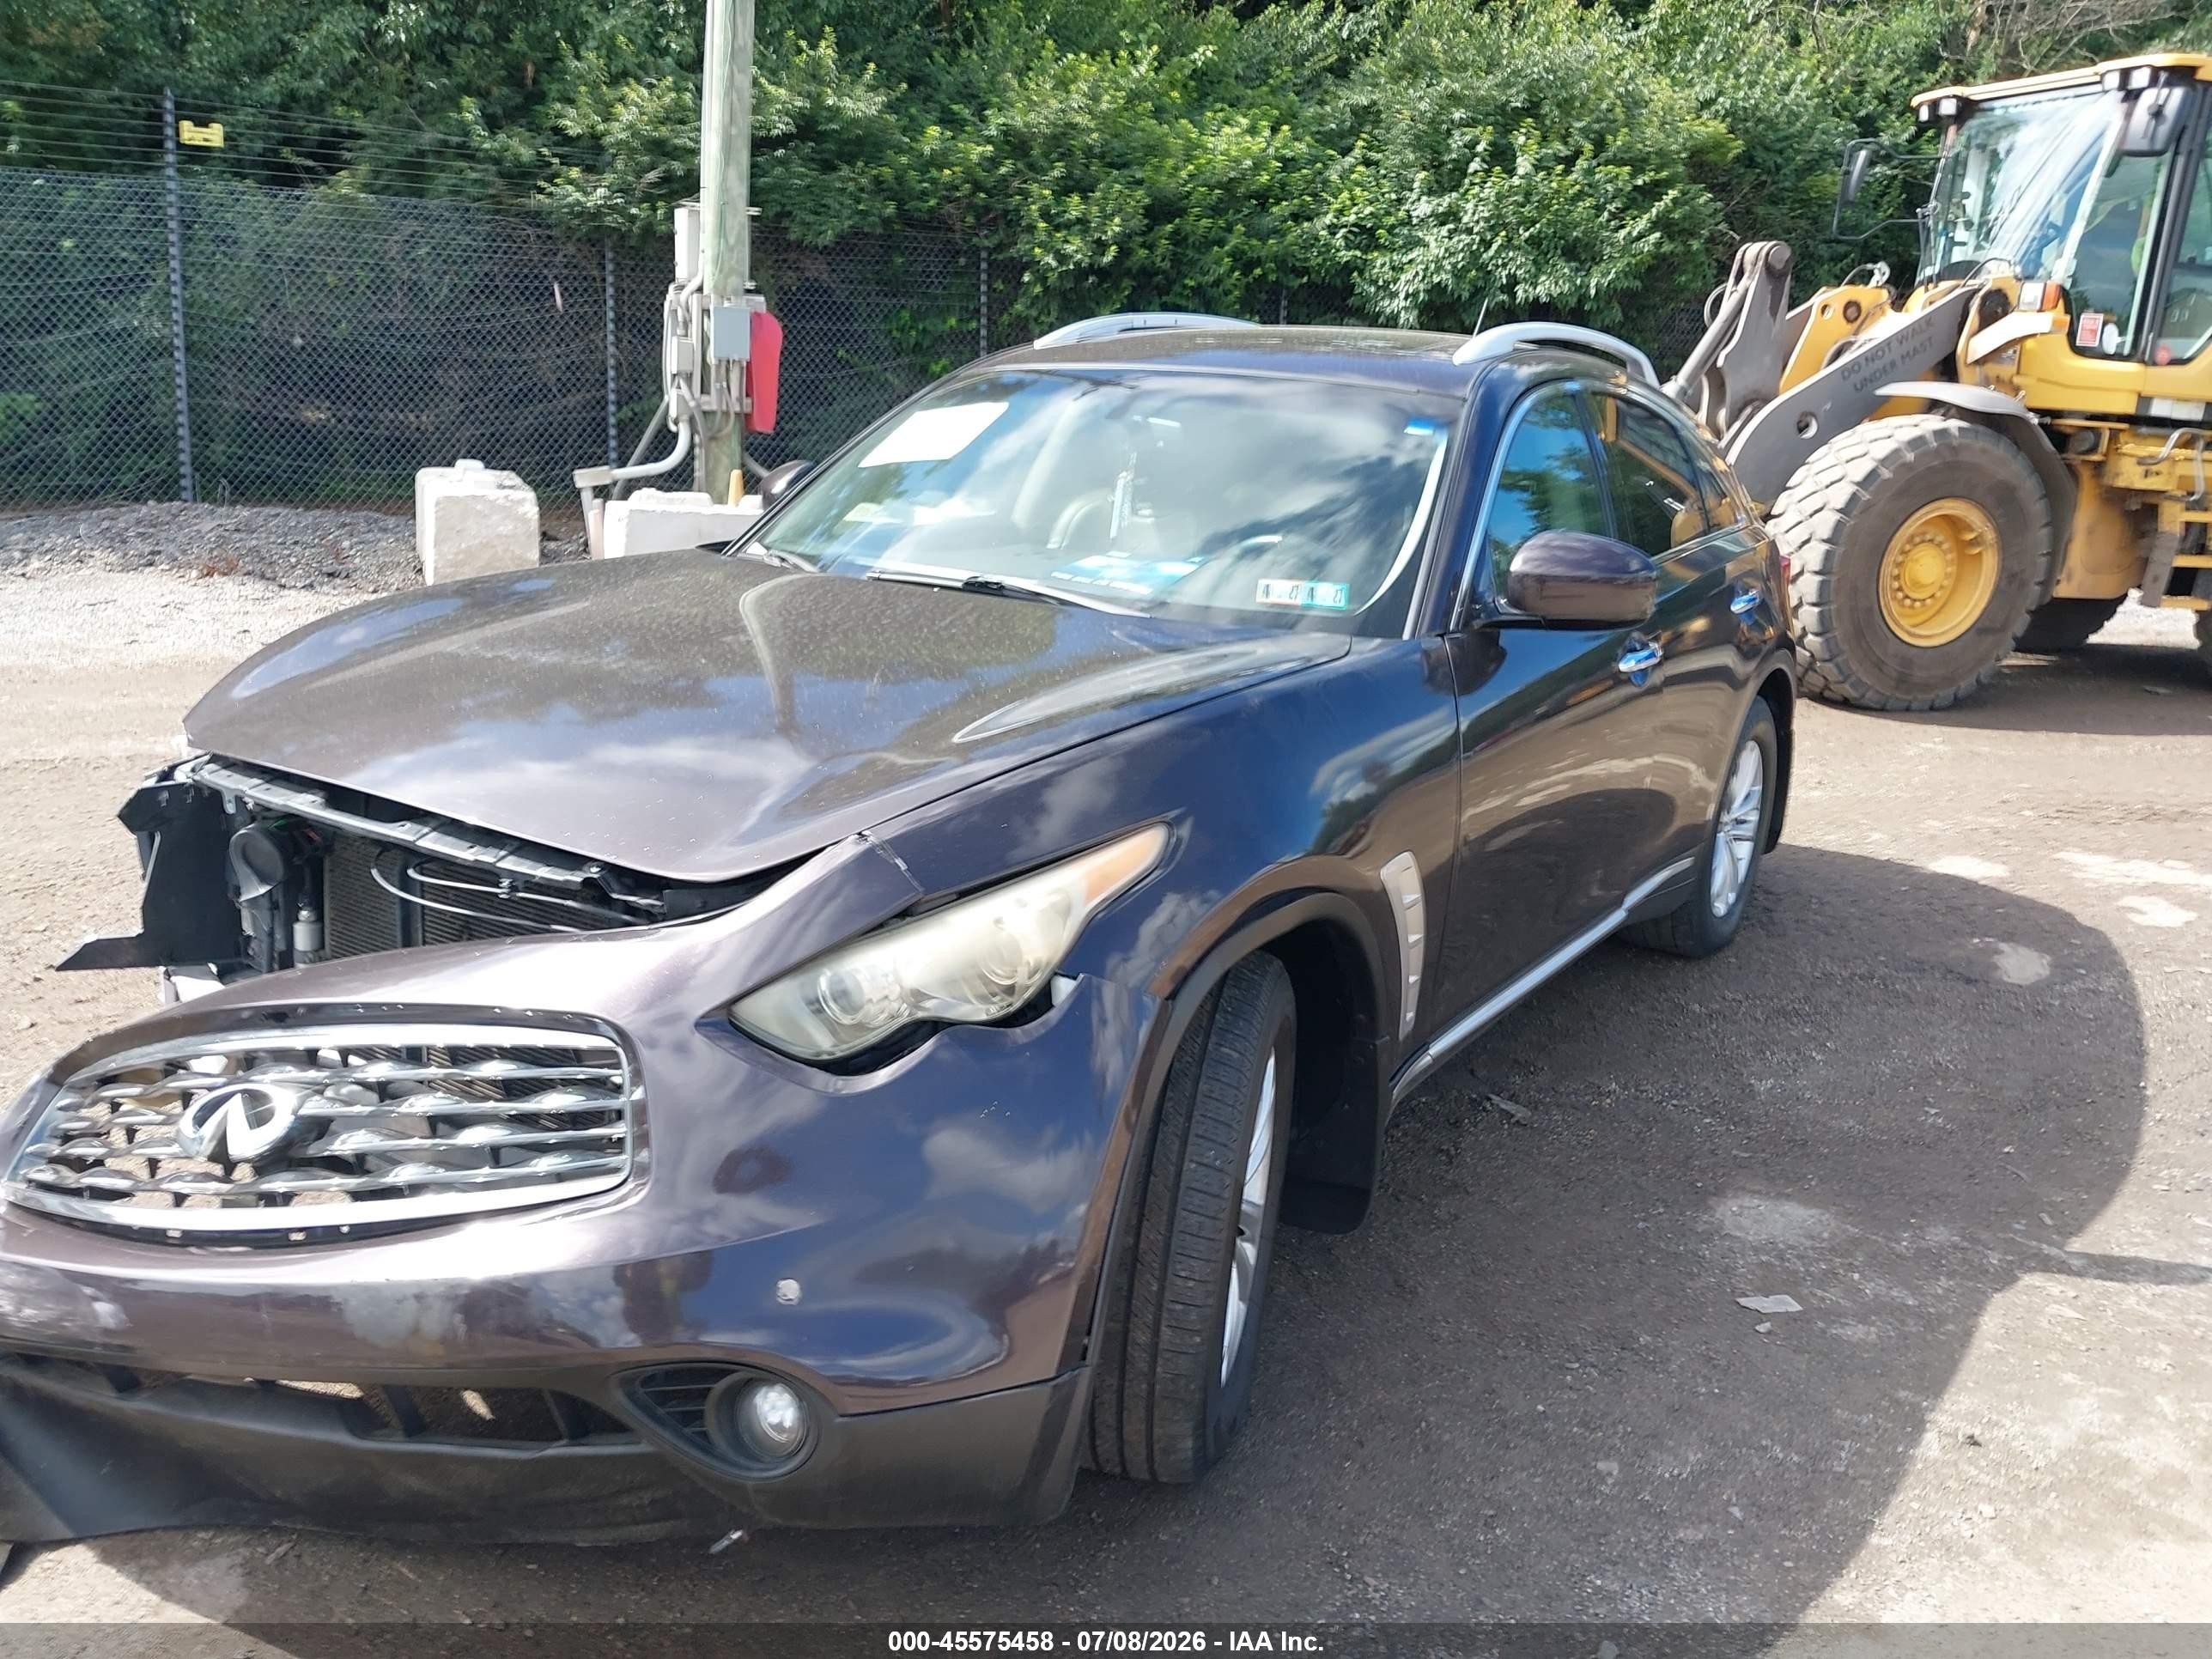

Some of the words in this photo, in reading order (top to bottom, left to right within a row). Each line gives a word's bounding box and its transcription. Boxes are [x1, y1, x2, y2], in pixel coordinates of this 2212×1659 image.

[1841, 360, 1863, 381] DO
[1864, 339, 1893, 367] NOT
[1895, 315, 1935, 345] WALK
[1853, 359, 1898, 392] UNDER
[1900, 335, 1934, 365] MAST
